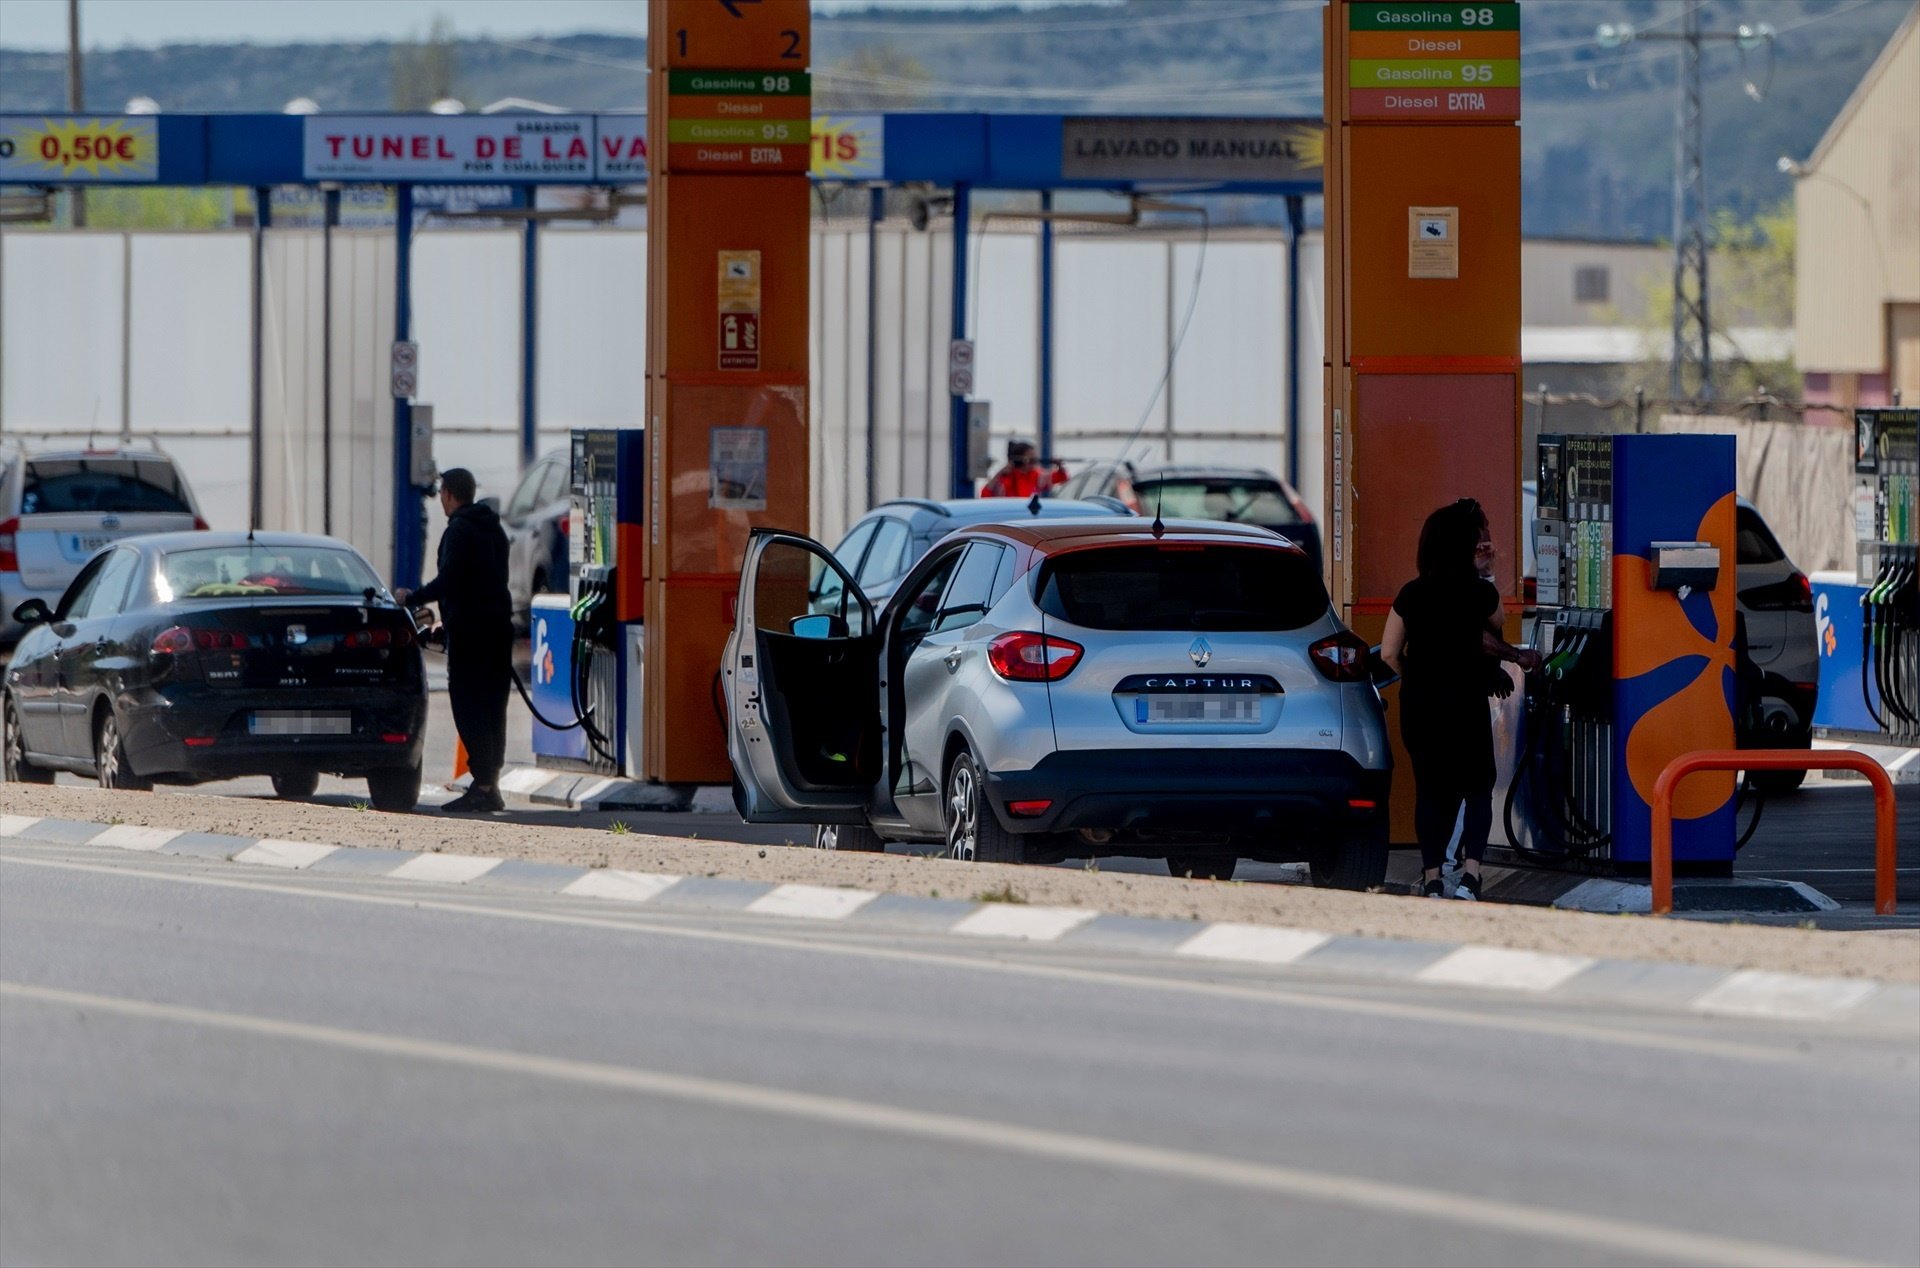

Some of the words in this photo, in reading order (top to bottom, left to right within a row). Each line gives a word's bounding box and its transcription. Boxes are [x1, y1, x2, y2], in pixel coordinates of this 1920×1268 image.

[1376, 11, 1453, 23] Gasolina
[1460, 8, 1494, 25] 98
[676, 29, 688, 57] 1
[780, 29, 802, 59] 2
[1408, 39, 1462, 51] Diesel
[1376, 67, 1453, 80] Gasolina
[1461, 65, 1493, 82] 95
[691, 78, 755, 90] Gasolina
[761, 76, 791, 92] 98
[717, 102, 763, 113] Diesel
[1384, 95, 1438, 108] Diesel
[1448, 93, 1486, 110] EXTRA
[691, 126, 755, 138] Gasolina
[761, 124, 789, 139] 95
[40, 134, 134, 166] 0,50€
[325, 135, 456, 160] TUNEL
[475, 135, 523, 160] DE
[543, 135, 589, 160] LA
[810, 133, 858, 161] IS
[1075, 137, 1180, 159] LAVADO
[1189, 137, 1300, 160] MANUAL
[697, 149, 742, 161] Diesel
[750, 148, 783, 164] EXTRA
[1589, 522, 1601, 543] 95
[1146, 679, 1252, 688] CAPTUR
